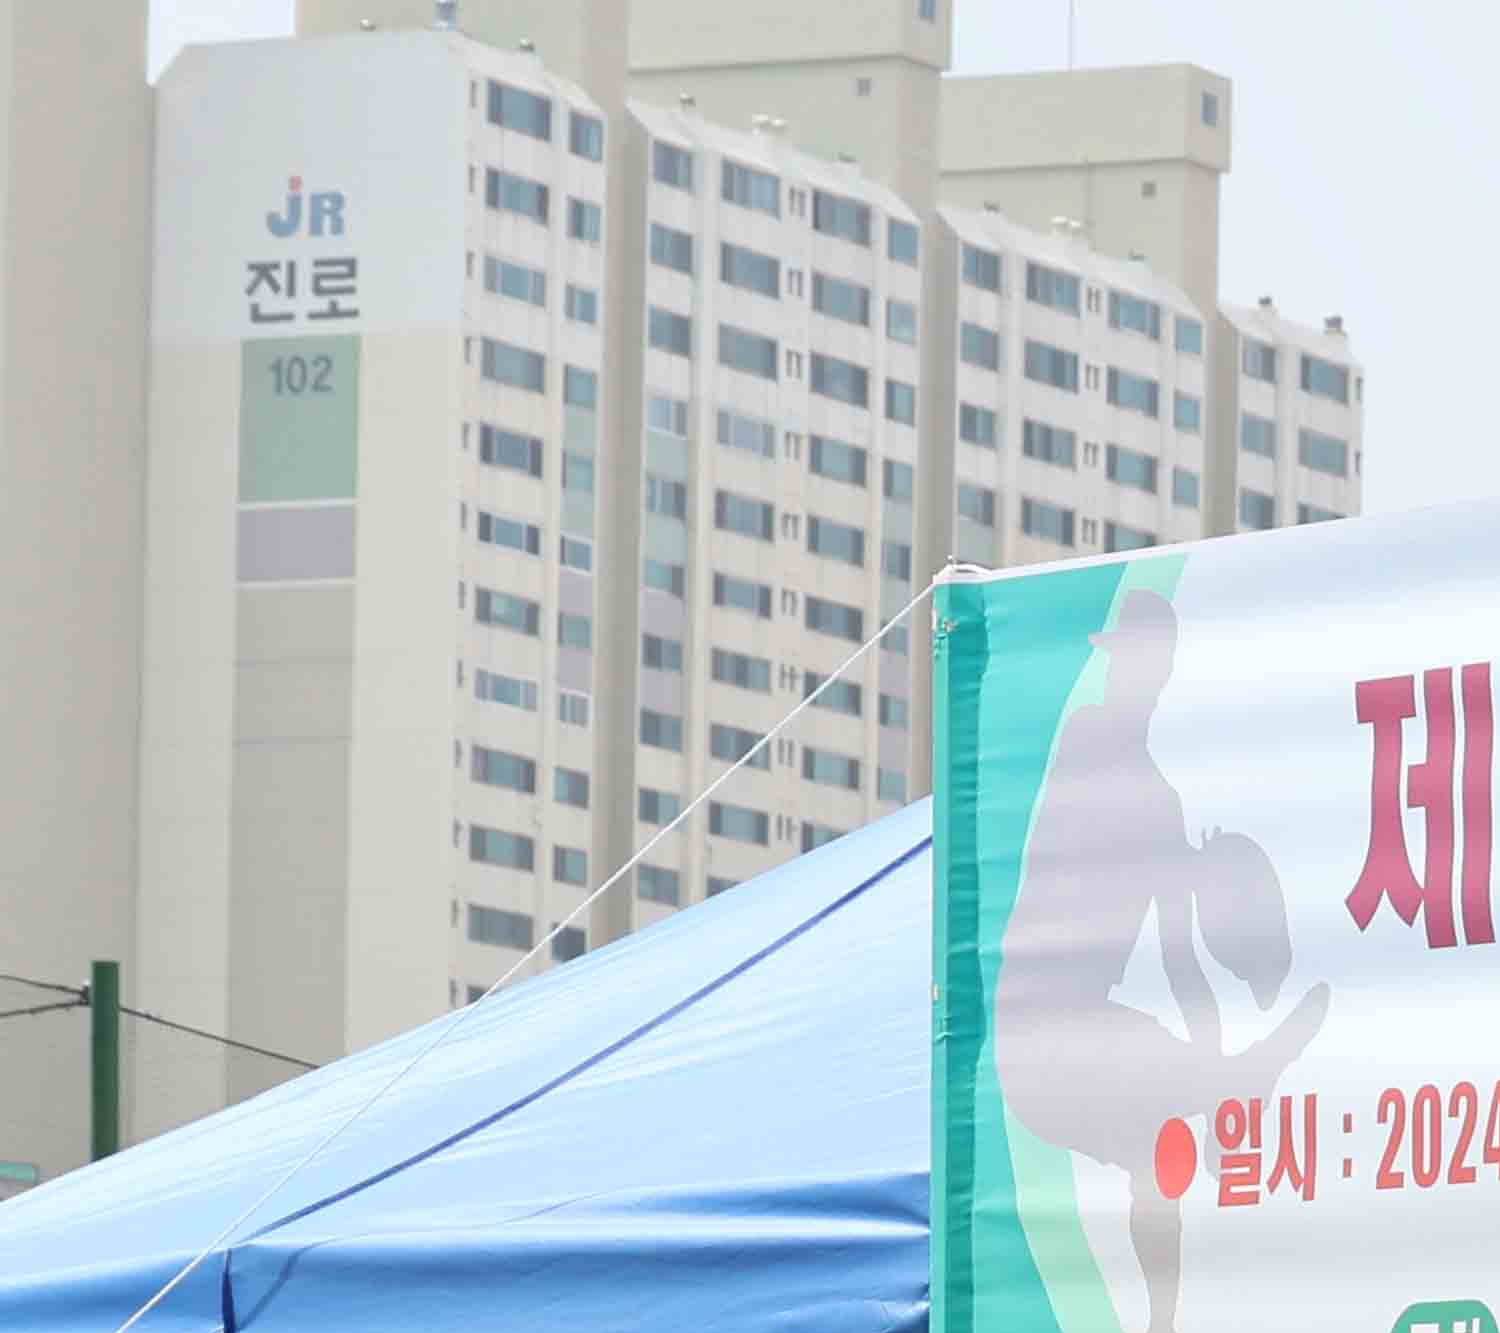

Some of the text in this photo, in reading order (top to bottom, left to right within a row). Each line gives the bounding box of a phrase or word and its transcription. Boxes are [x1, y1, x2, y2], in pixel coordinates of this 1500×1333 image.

[244, 256, 360, 324] 진로
[267, 354, 334, 397] 102
[1215, 1094, 1317, 1208] 일시
